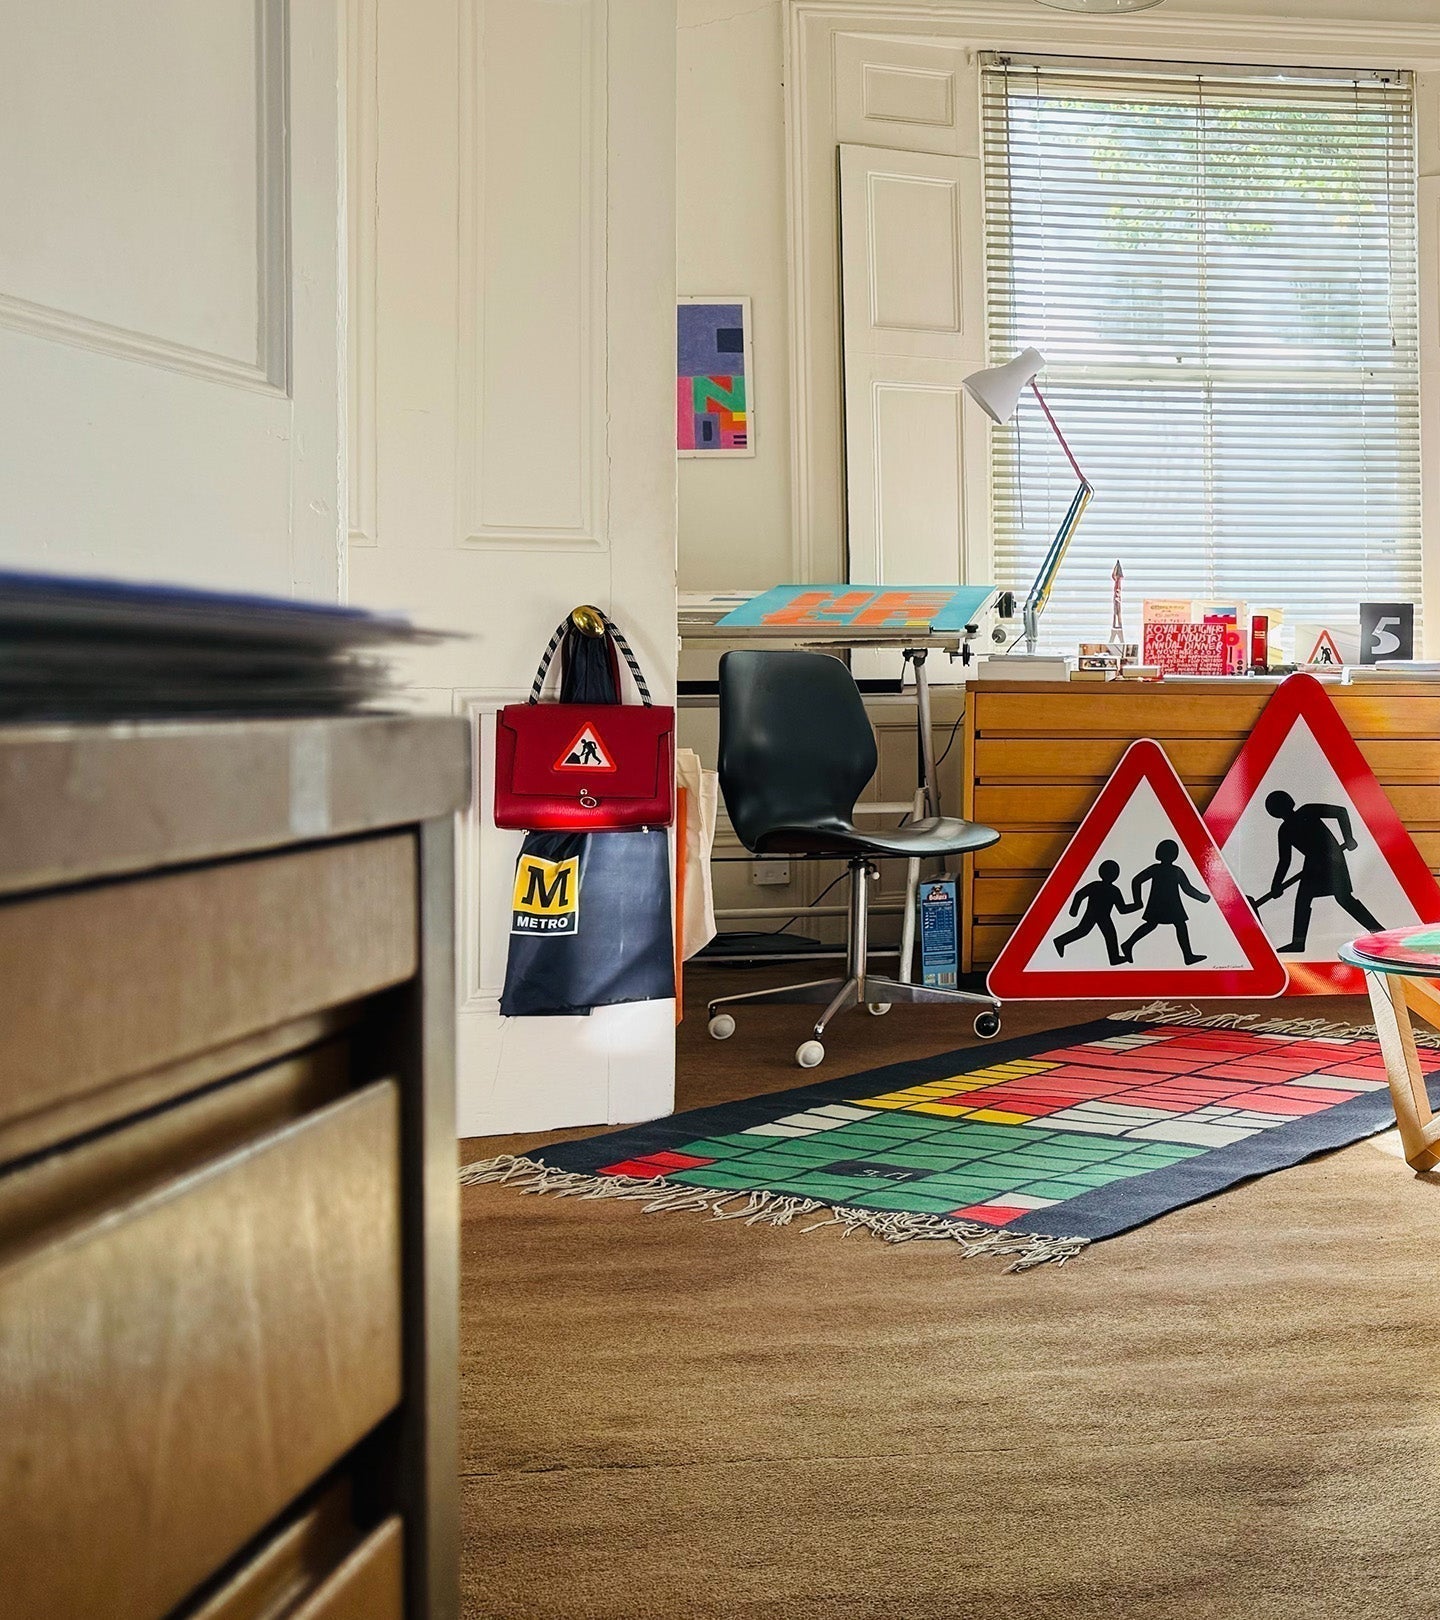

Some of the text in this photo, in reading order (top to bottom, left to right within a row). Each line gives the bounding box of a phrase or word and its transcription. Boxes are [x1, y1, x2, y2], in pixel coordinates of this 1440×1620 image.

[1146, 624, 1224, 635] ROYAL DESIGNERS
[1371, 616, 1401, 655] 5
[1146, 633, 1222, 643] FOR INDUSTRY
[1145, 641, 1223, 651] ANNUAL DINNER
[521, 865, 571, 908] M
[517, 915, 568, 929] METRO
